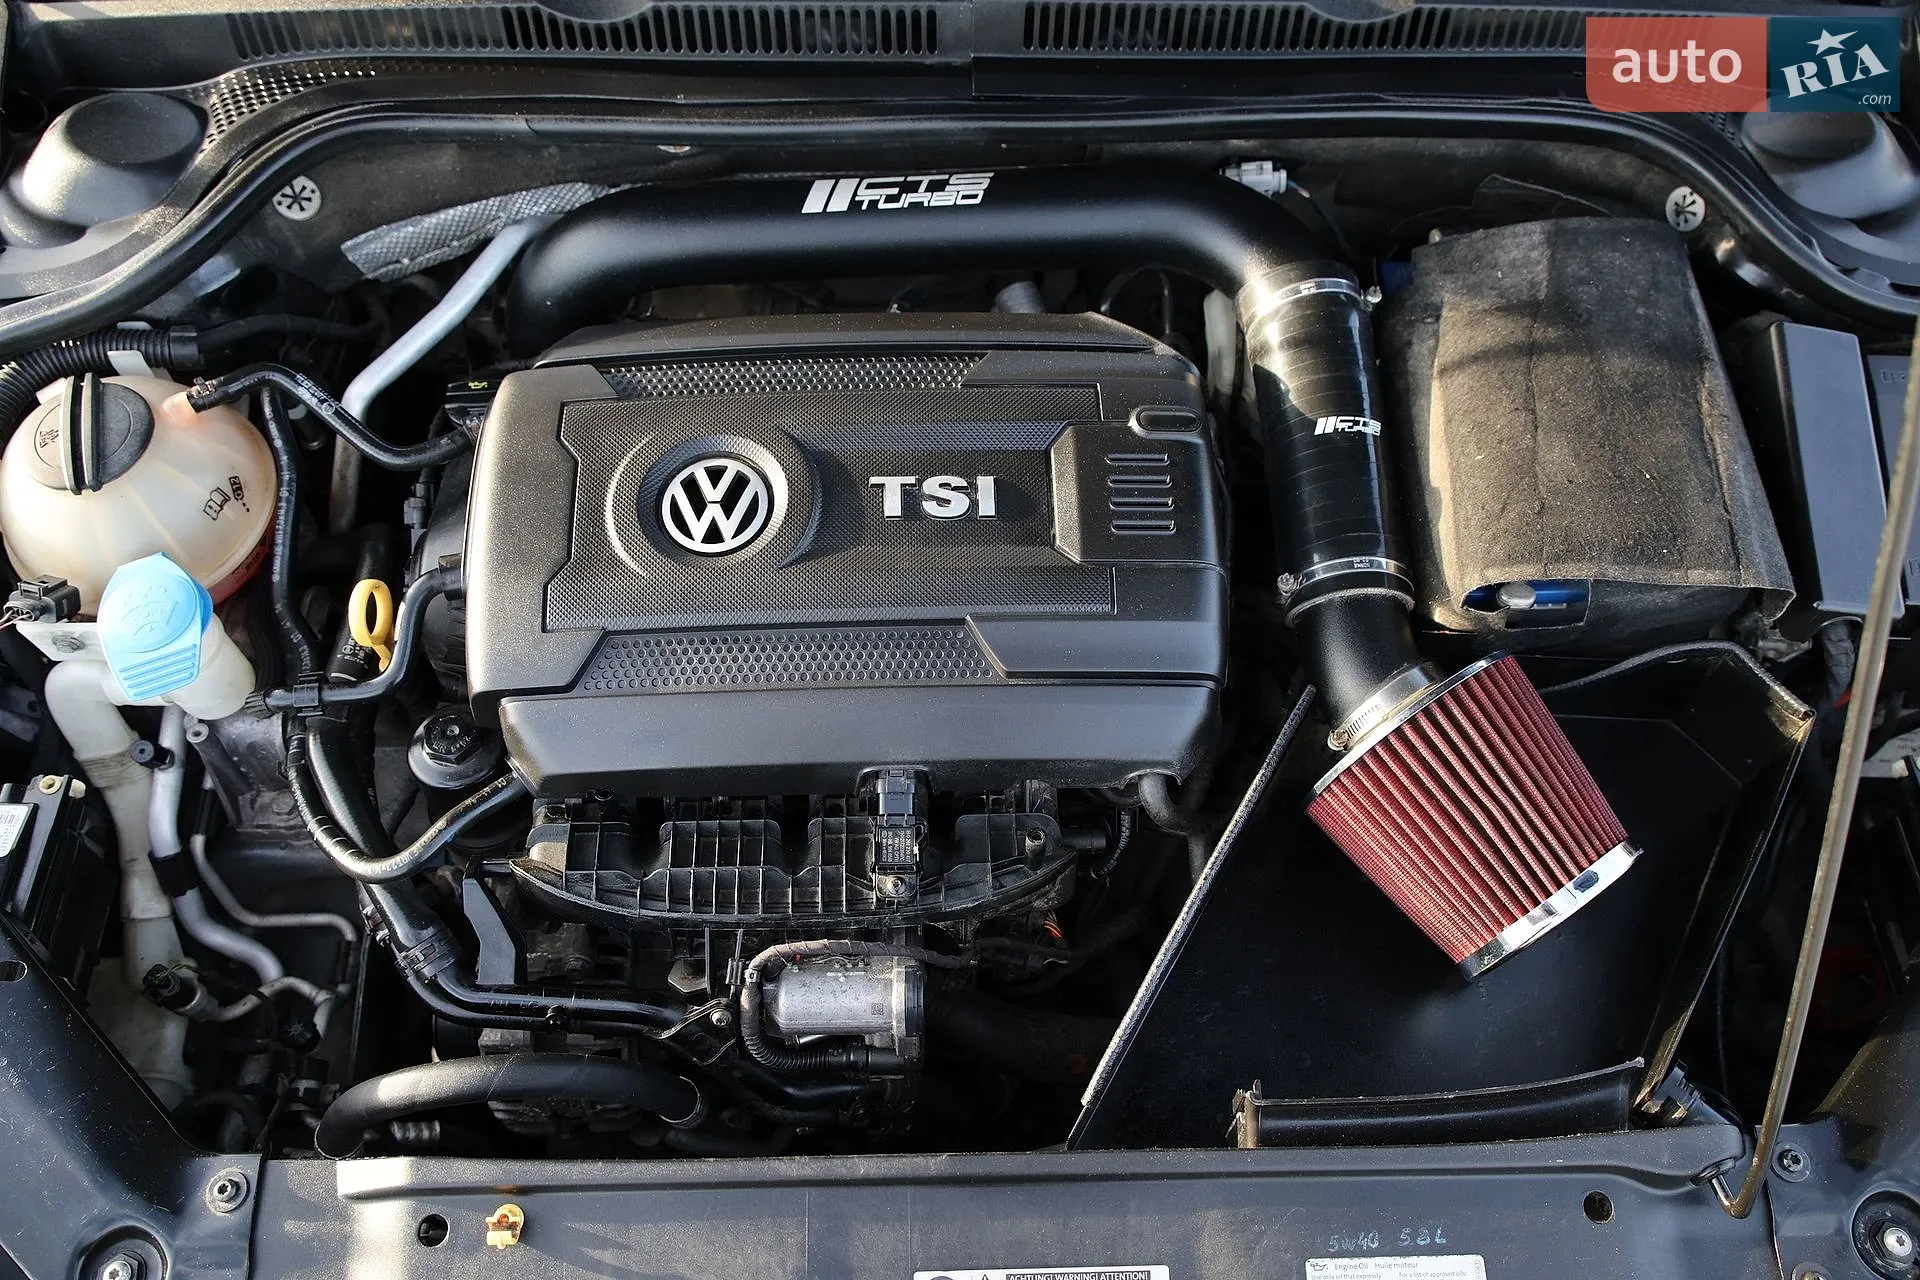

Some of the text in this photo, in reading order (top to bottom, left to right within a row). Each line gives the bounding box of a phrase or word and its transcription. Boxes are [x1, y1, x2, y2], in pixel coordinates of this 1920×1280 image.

[857, 172, 995, 196] CTS
[855, 190, 984, 210] TURBO
[869, 475, 998, 520] TSI
[1100, 1271, 1149, 1280] ATTENTION!
[1334, 1263, 1357, 1272] Engine
